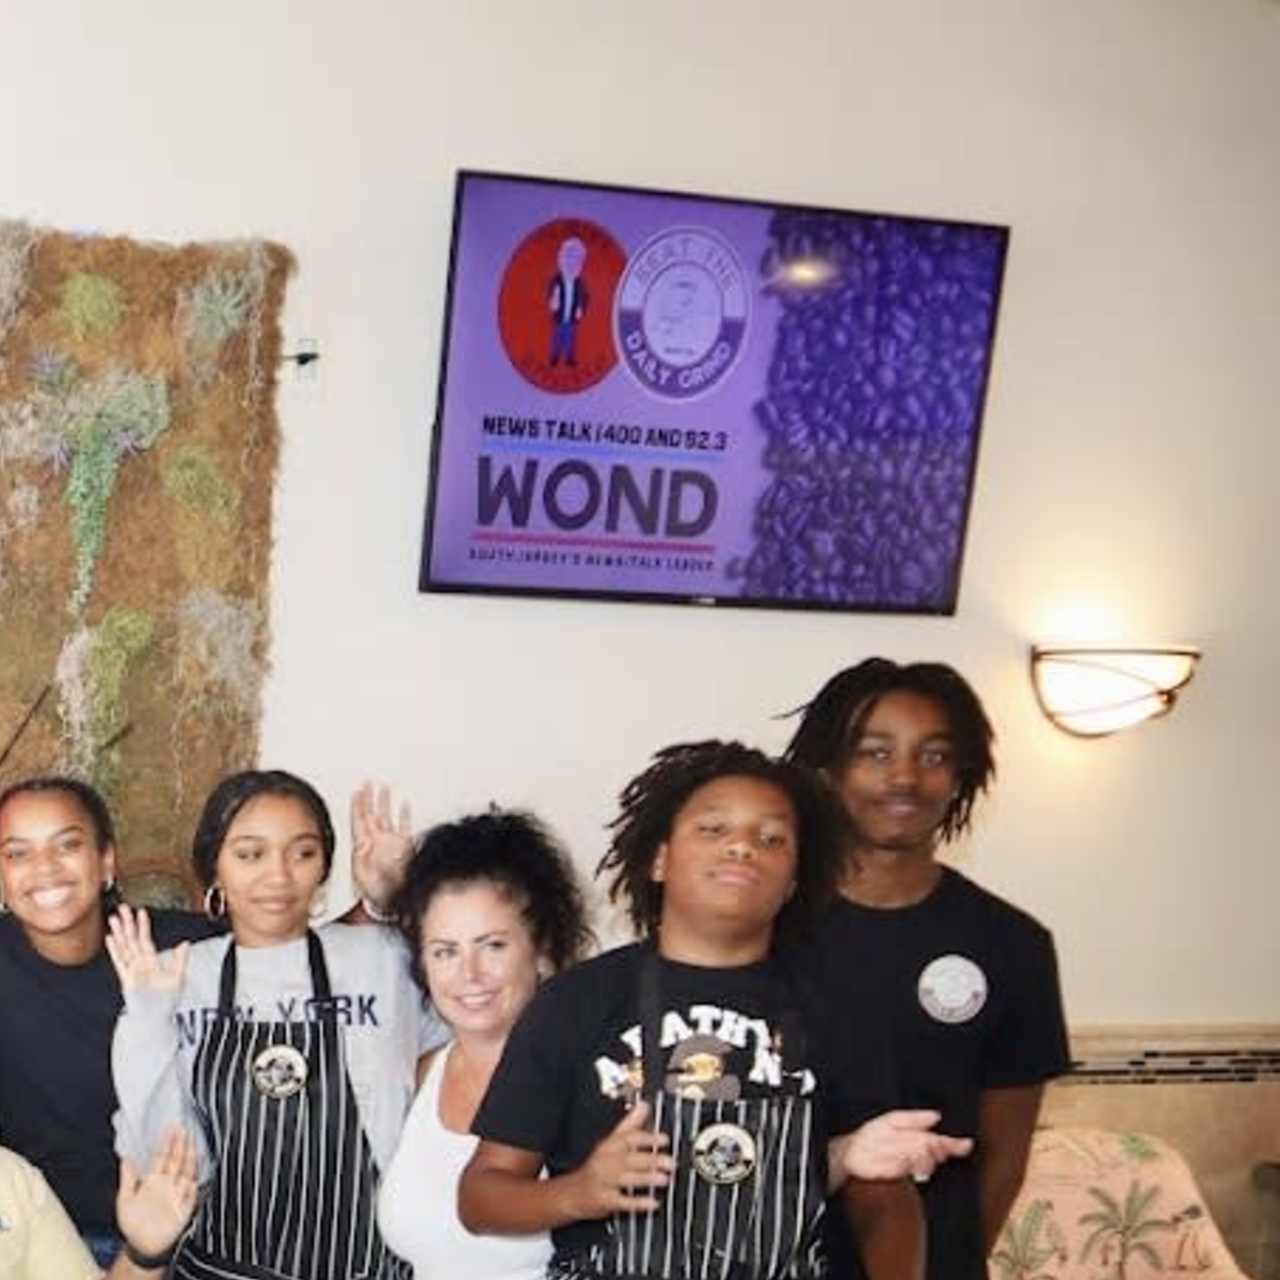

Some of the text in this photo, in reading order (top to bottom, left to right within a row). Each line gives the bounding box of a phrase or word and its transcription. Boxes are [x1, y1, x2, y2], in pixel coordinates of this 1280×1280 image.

[625, 330, 674, 386] DAILY
[482, 415, 542, 439] NEWS
[543, 419, 591, 442] TALK
[644, 428, 682, 449] AND
[476, 455, 719, 538] WOND
